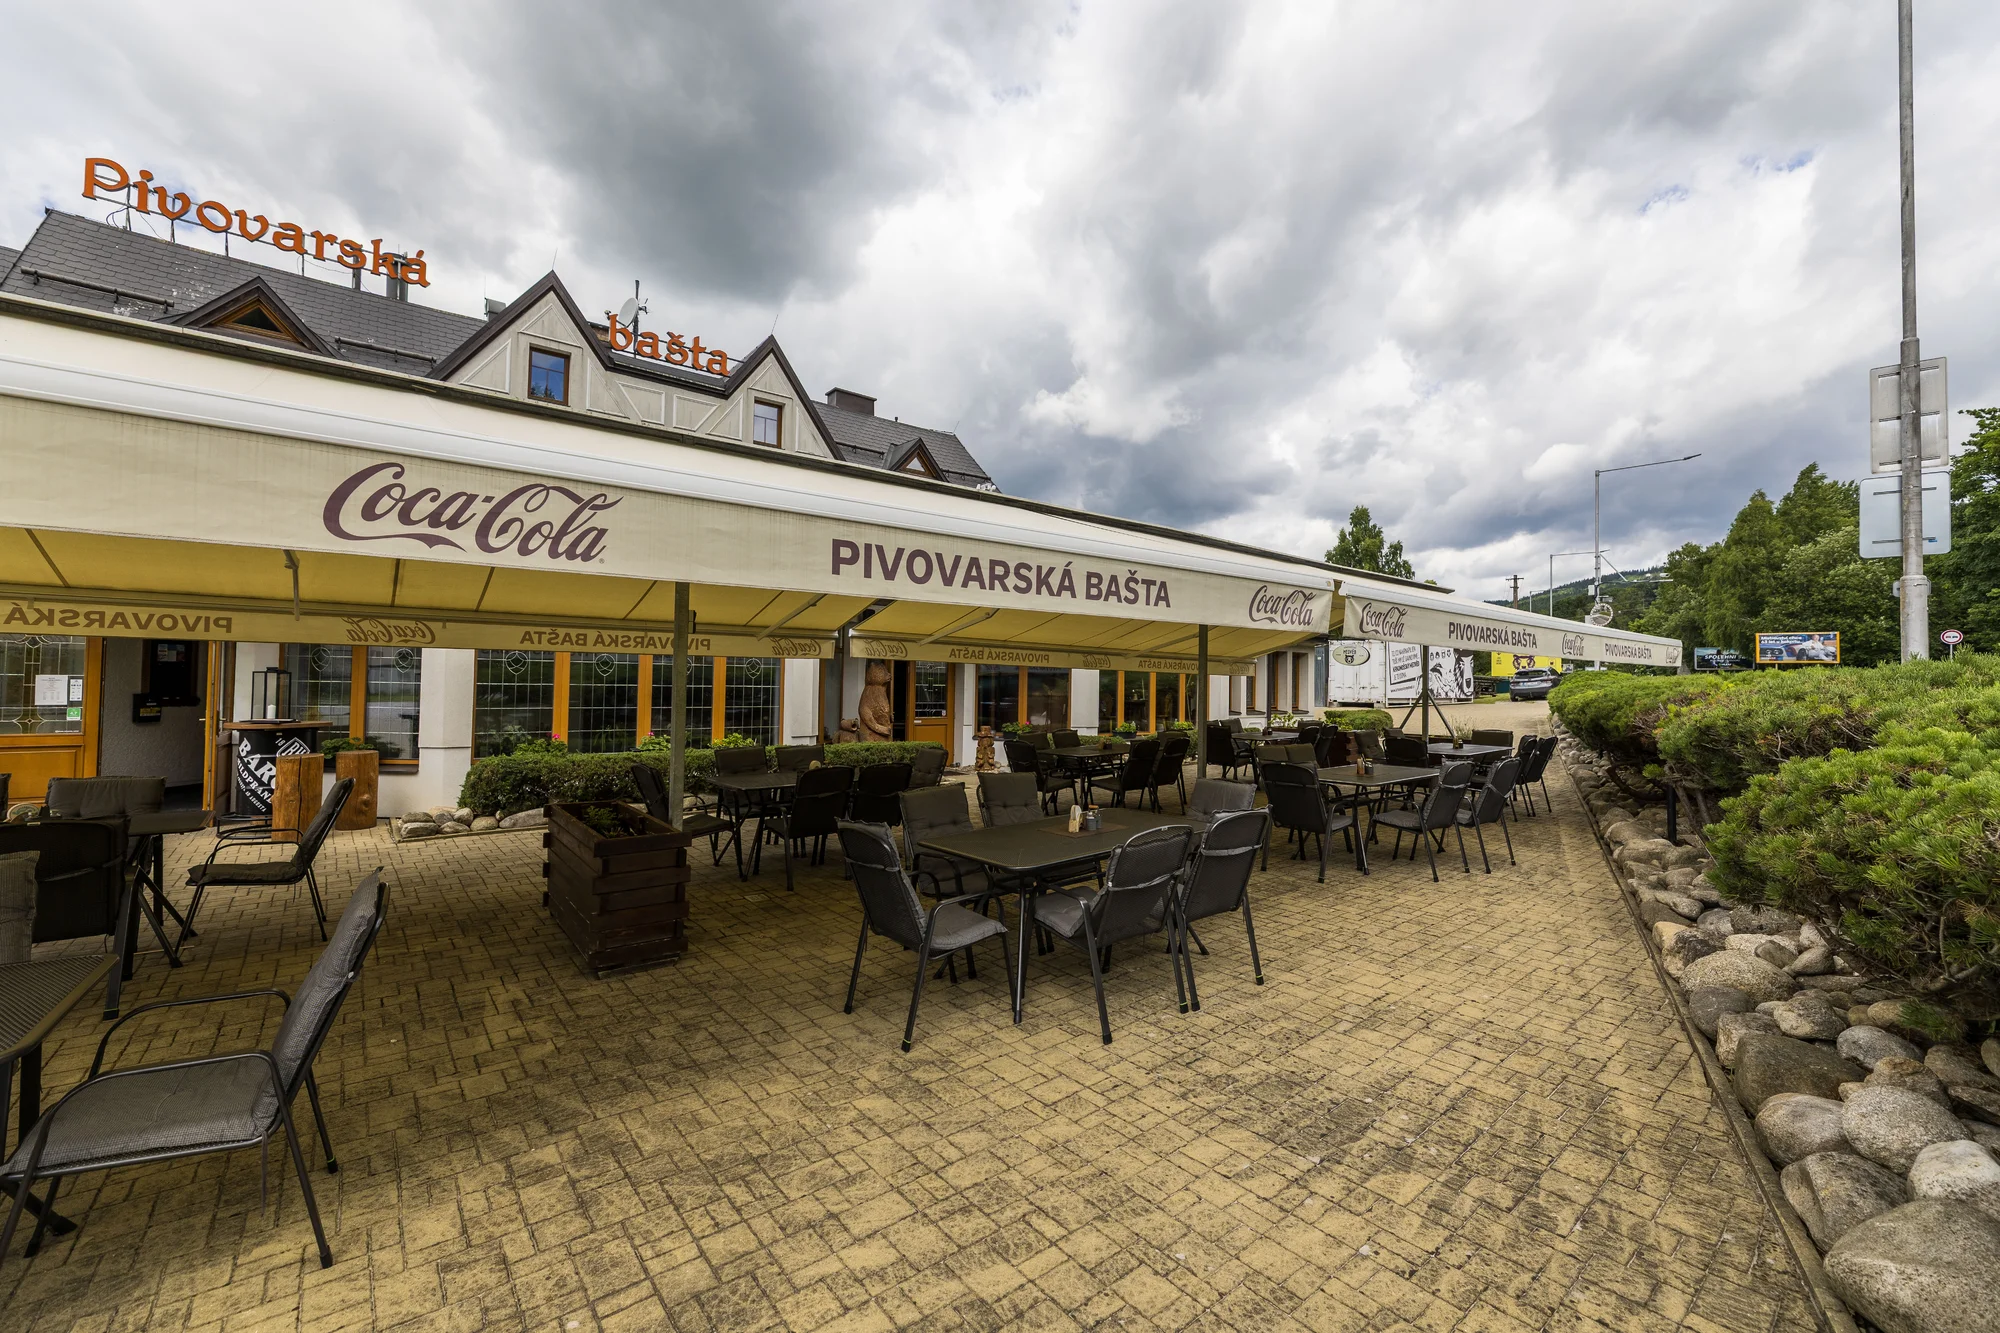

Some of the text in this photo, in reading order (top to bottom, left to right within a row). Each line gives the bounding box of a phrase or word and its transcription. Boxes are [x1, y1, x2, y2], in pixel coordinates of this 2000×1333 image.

[82, 157, 431, 288] Pivovarská
[609, 313, 730, 376] bašta
[322, 462, 624, 563] Coca-Cola
[831, 538, 1171, 608] PIVOVARSKÁ BAŠTA
[1248, 585, 1317, 626] Coca-Cola
[1359, 602, 1408, 638] Coca-Cola
[1448, 621, 1537, 649] PIVOVARSKÁ BAŠTA
